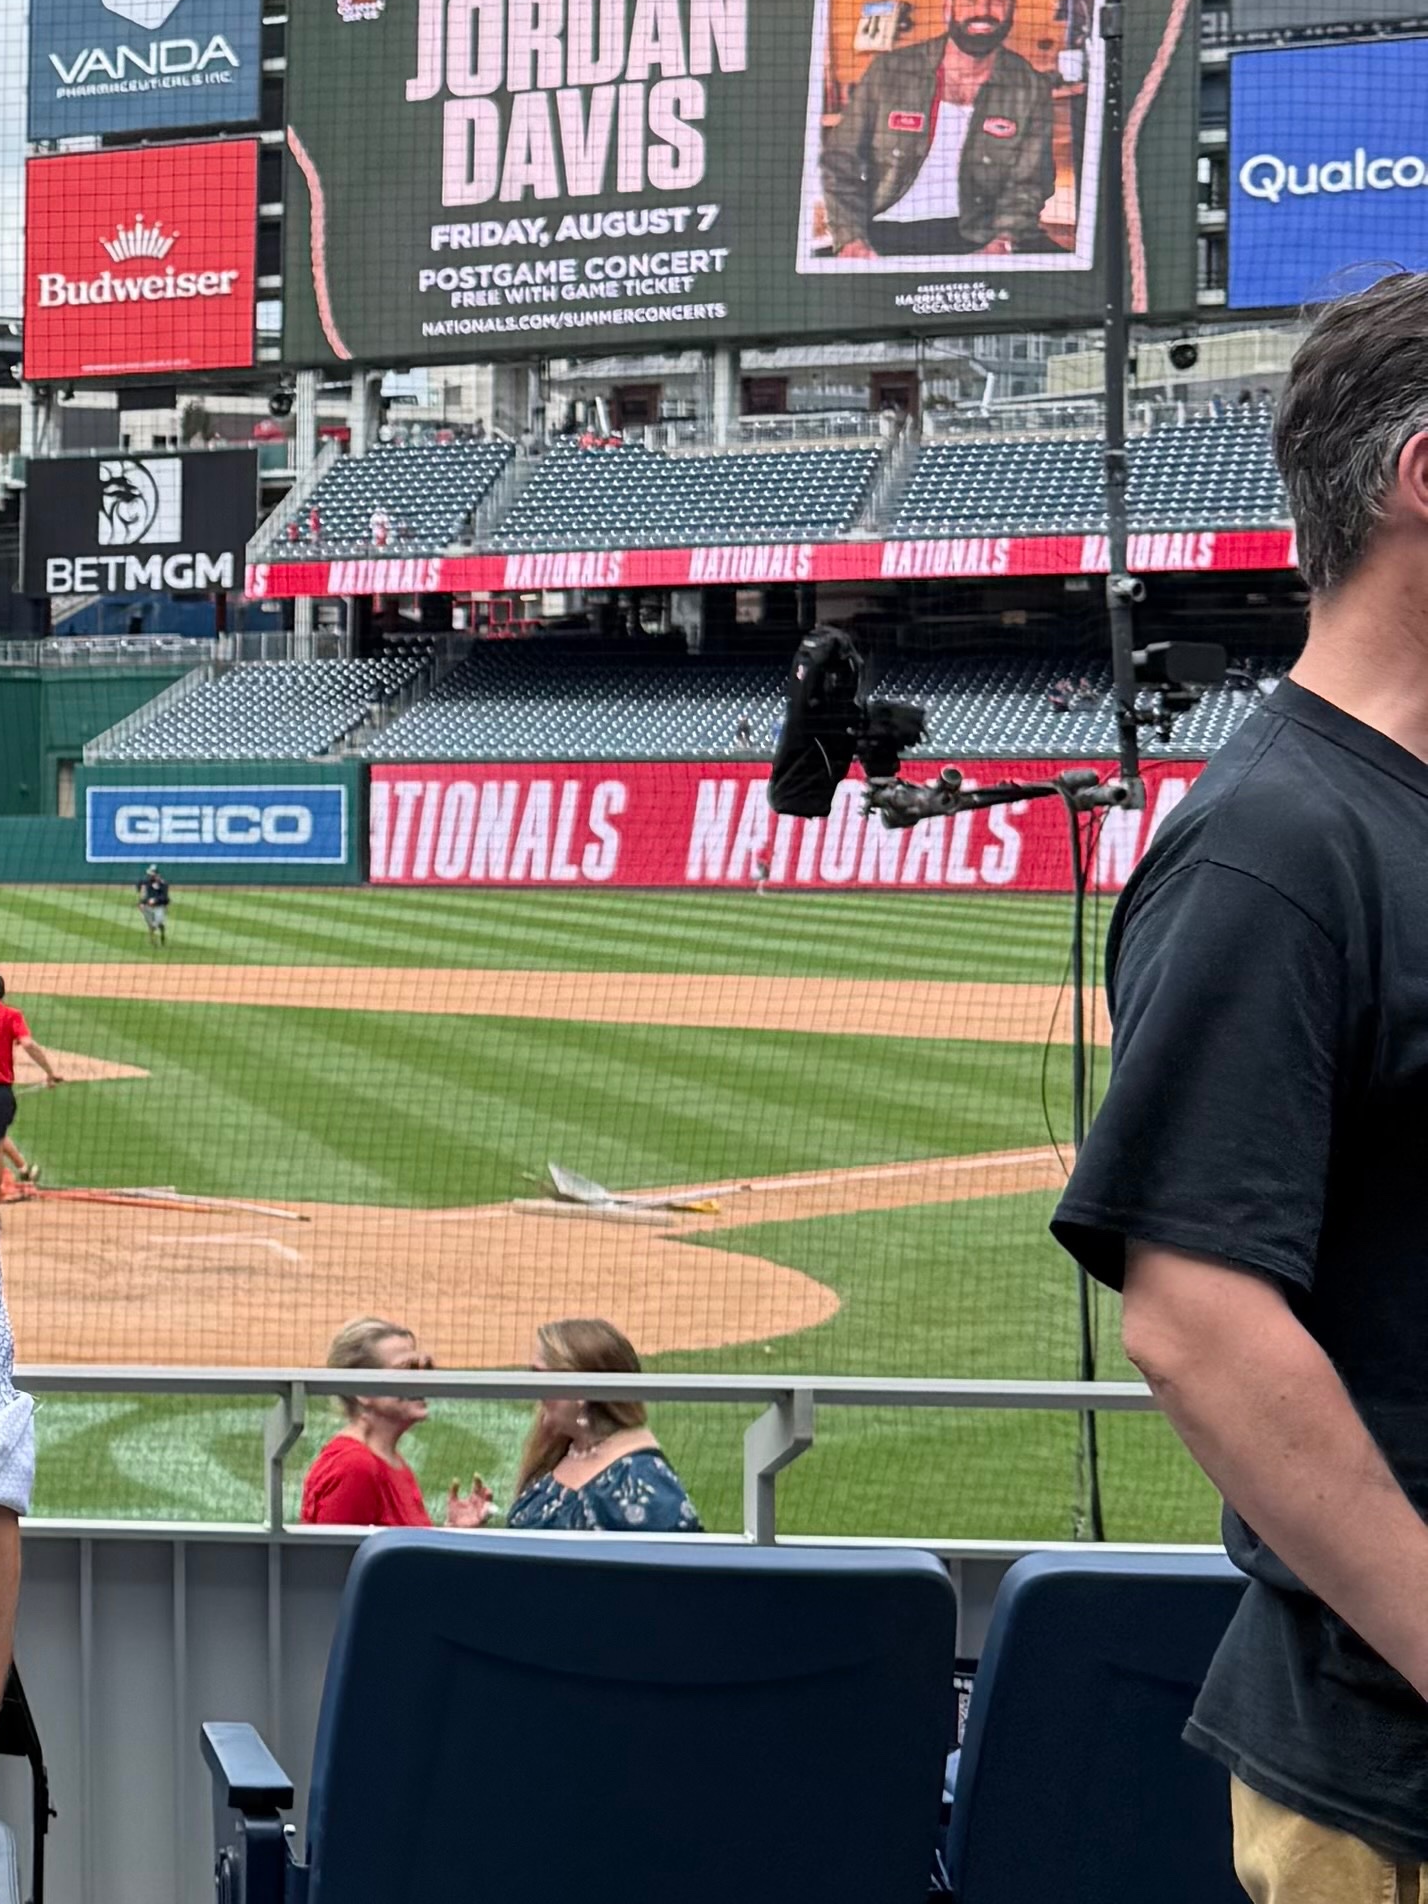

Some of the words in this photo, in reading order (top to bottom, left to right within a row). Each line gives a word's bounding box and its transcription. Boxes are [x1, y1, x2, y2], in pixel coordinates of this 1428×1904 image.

[48, 34, 241, 84] VANDA
[441, 77, 707, 207] DAVIS
[1239, 146, 1428, 204] Qualco
[430, 217, 549, 251] FRIDAY,
[555, 206, 691, 241] AUGUST
[696, 204, 722, 232] 7
[37, 264, 240, 308] Budweiser
[418, 258, 577, 293] POSTGAME
[584, 248, 732, 280] CONCERT
[450, 291, 502, 309] FREE
[503, 286, 558, 306] WITH
[560, 281, 619, 301] GAME
[623, 275, 695, 298] TICKET
[421, 302, 728, 337] NATIONALS.COM/SUMMERCONCERTS
[46, 552, 234, 594] BETMGM
[505, 552, 623, 589] NATIONALS
[689, 545, 813, 582] NATIONALS
[881, 538, 1010, 576] NATIONALS
[1081, 533, 1216, 571] NAIONALS
[327, 557, 442, 594] NATIONALS
[114, 803, 313, 846] GEICO
